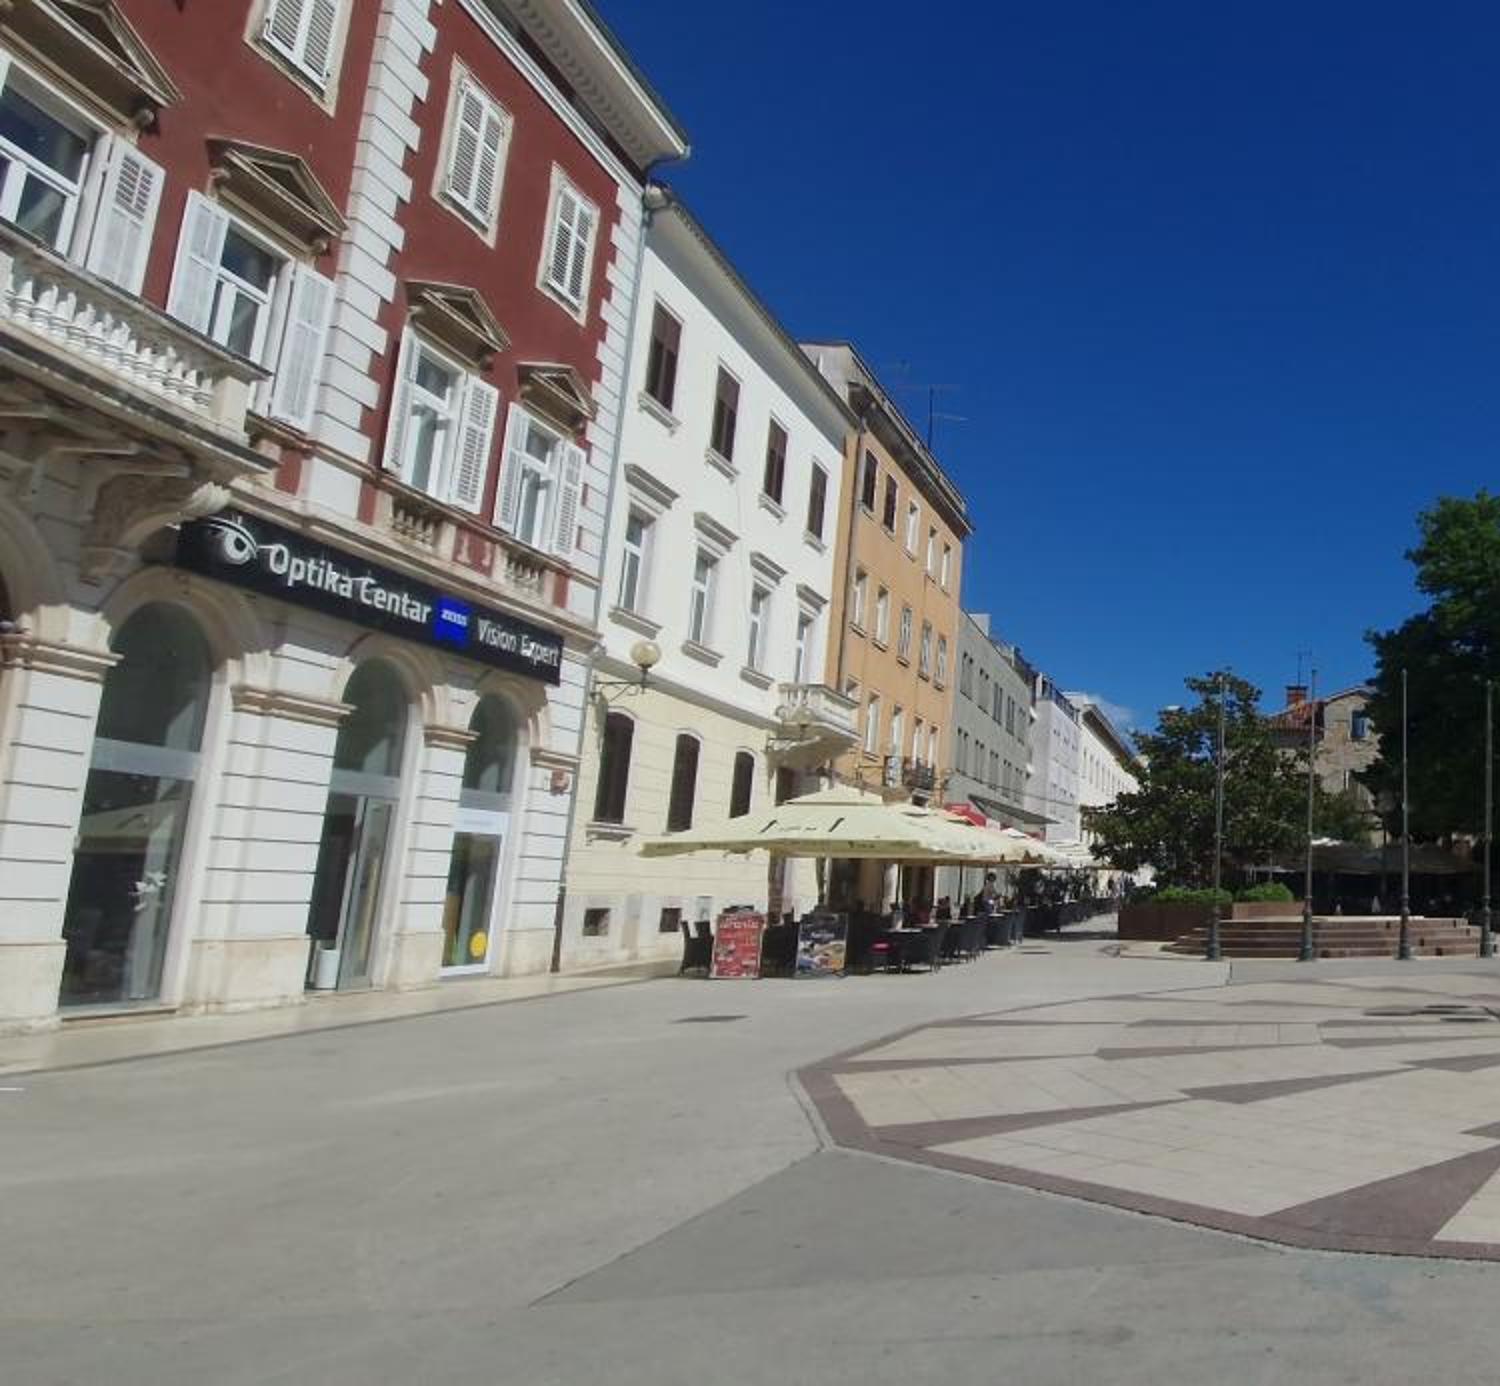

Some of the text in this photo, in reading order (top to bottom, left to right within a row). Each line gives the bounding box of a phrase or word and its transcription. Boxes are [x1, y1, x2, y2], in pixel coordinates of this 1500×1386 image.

[269, 543, 432, 623] Optika Centar
[478, 618, 559, 666] Vision Expert
